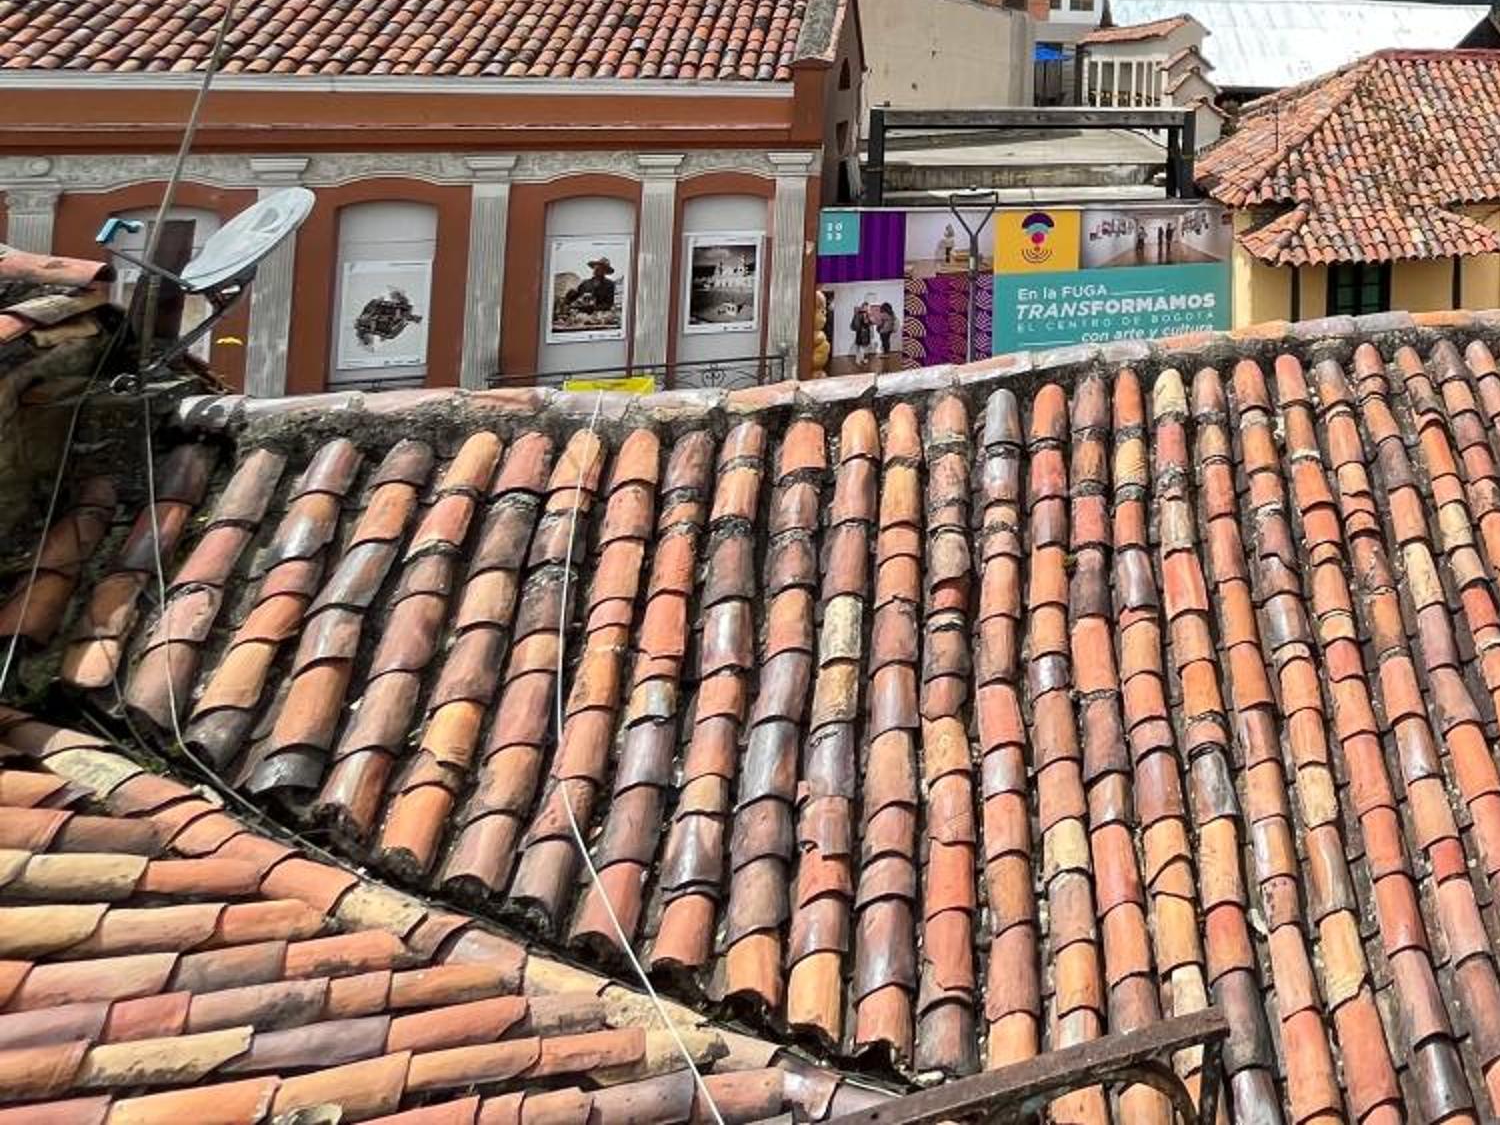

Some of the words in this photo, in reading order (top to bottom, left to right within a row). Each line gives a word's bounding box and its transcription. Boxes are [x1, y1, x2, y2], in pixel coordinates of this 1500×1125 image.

[1018, 288, 1037, 301] En
[1043, 286, 1057, 300] la
[1062, 284, 1107, 299] FUGA
[1016, 293, 1216, 320] TRANSFORMAMOS
[1017, 322, 1035, 333] EL
[1045, 318, 1111, 331] CENTRO
[1121, 315, 1139, 326] DE
[1081, 332, 1109, 343] con
[1113, 328, 1145, 340] arte
